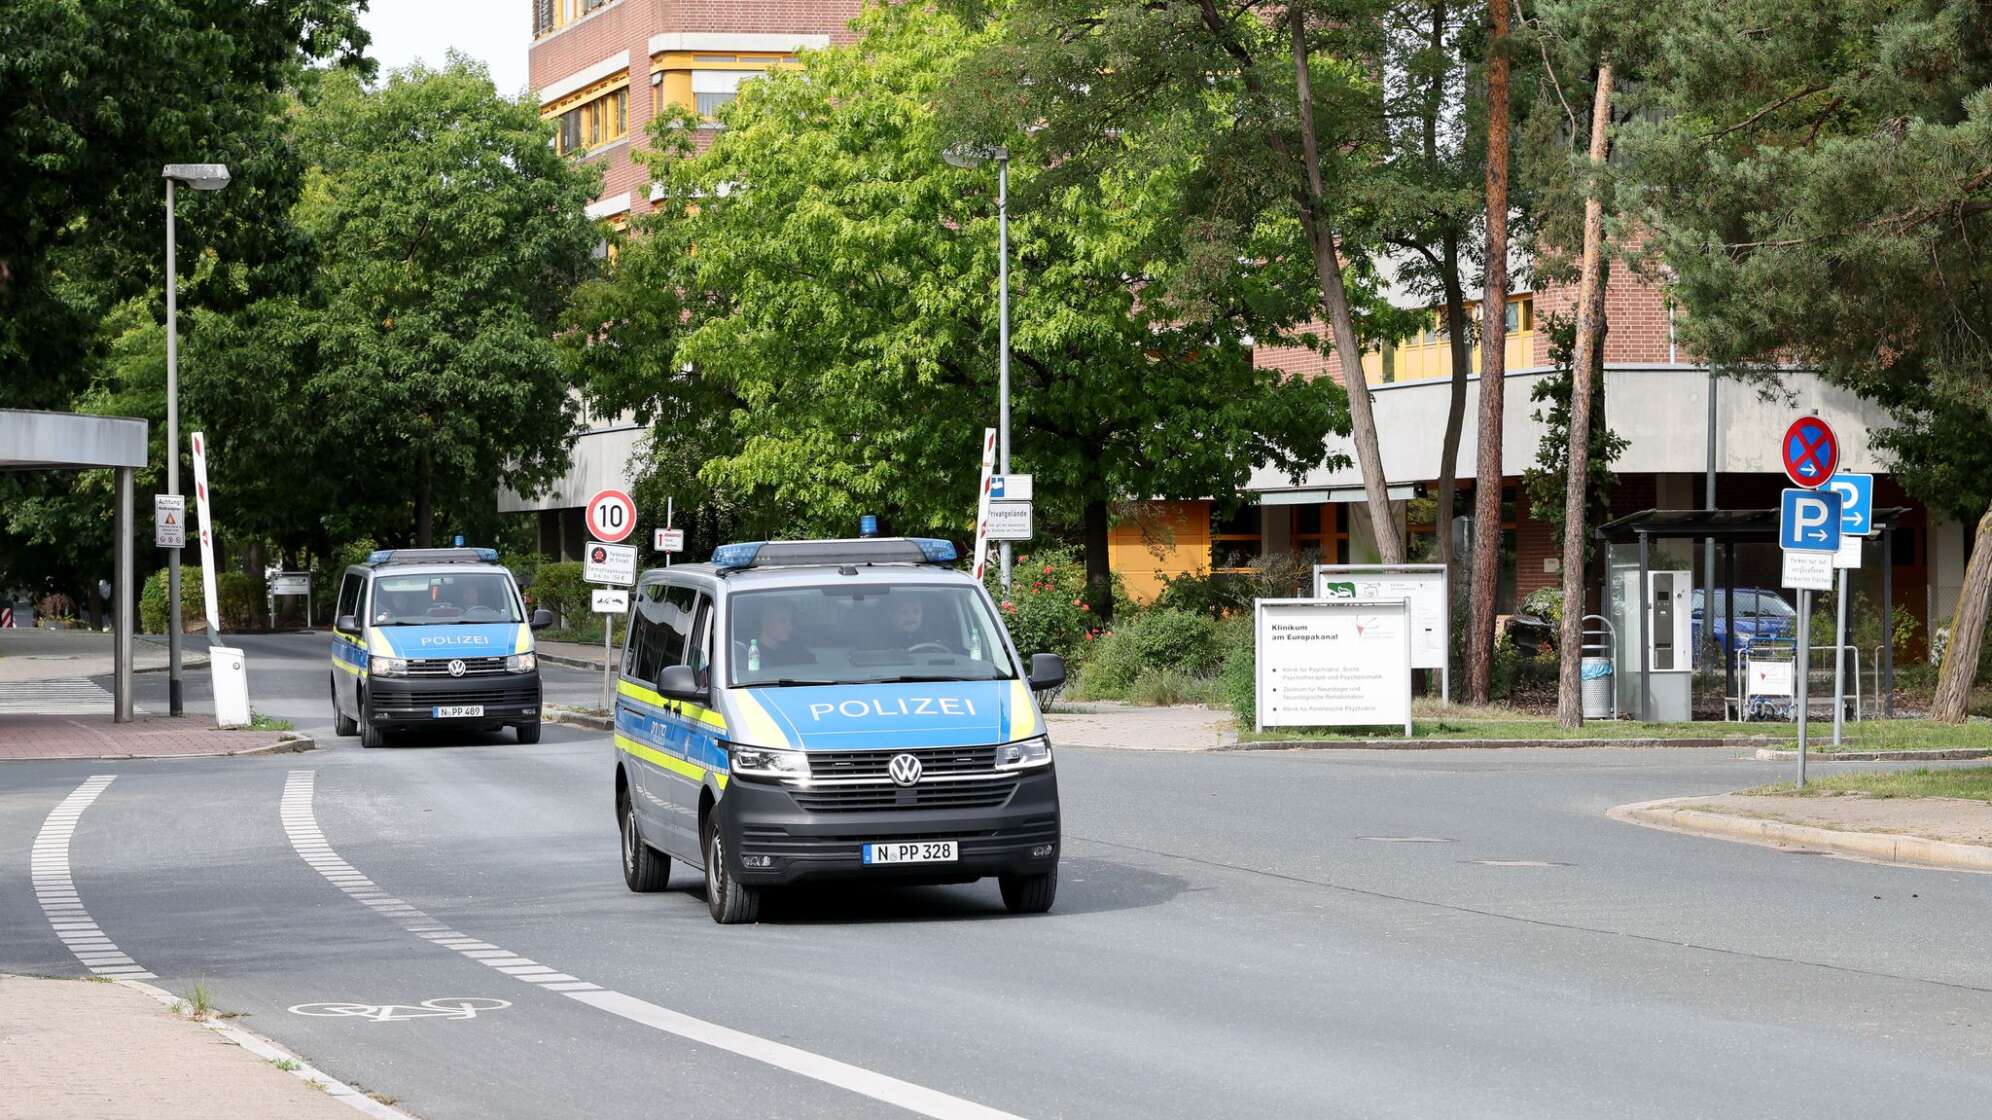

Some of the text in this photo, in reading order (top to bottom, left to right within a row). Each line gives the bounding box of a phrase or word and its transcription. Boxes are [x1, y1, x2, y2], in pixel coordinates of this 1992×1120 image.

[600, 504, 622, 528] 10
[1793, 498, 1829, 542] P
[421, 635, 489, 646] POLIZEI
[1286, 633, 1339, 642] Europakanal
[441, 706, 481, 716] N PP 489
[809, 697, 977, 721] POLIZEI
[878, 843, 952, 861] N PP 328
